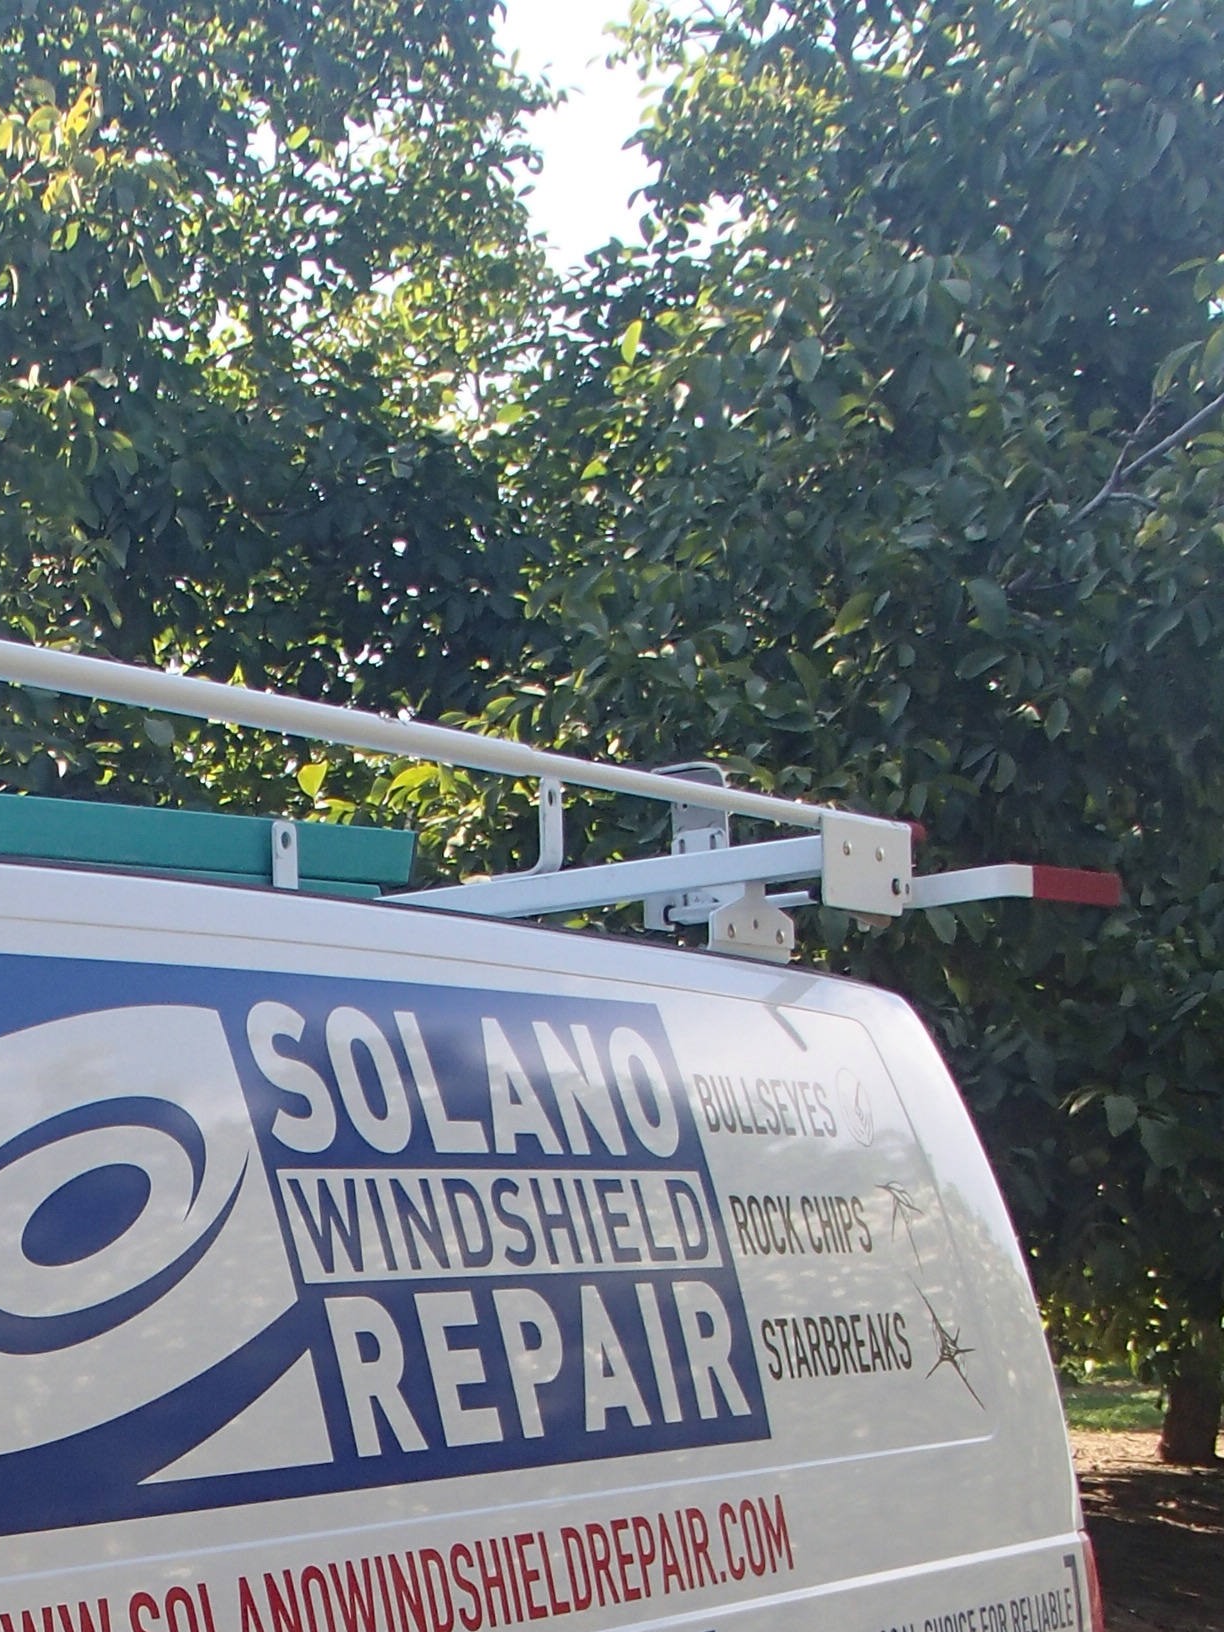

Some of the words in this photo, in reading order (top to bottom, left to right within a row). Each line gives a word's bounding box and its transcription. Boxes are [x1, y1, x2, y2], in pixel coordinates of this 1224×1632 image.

[246, 1000, 681, 1160] SOLANO
[692, 1073, 838, 1138] BULLSEYES
[287, 1176, 709, 1274] WINDSHIELD
[728, 1194, 806, 1256] ROCK
[799, 1194, 873, 1254] CHIPS
[323, 1279, 752, 1458] REPAIR
[761, 1311, 913, 1380] STARBREAKS
